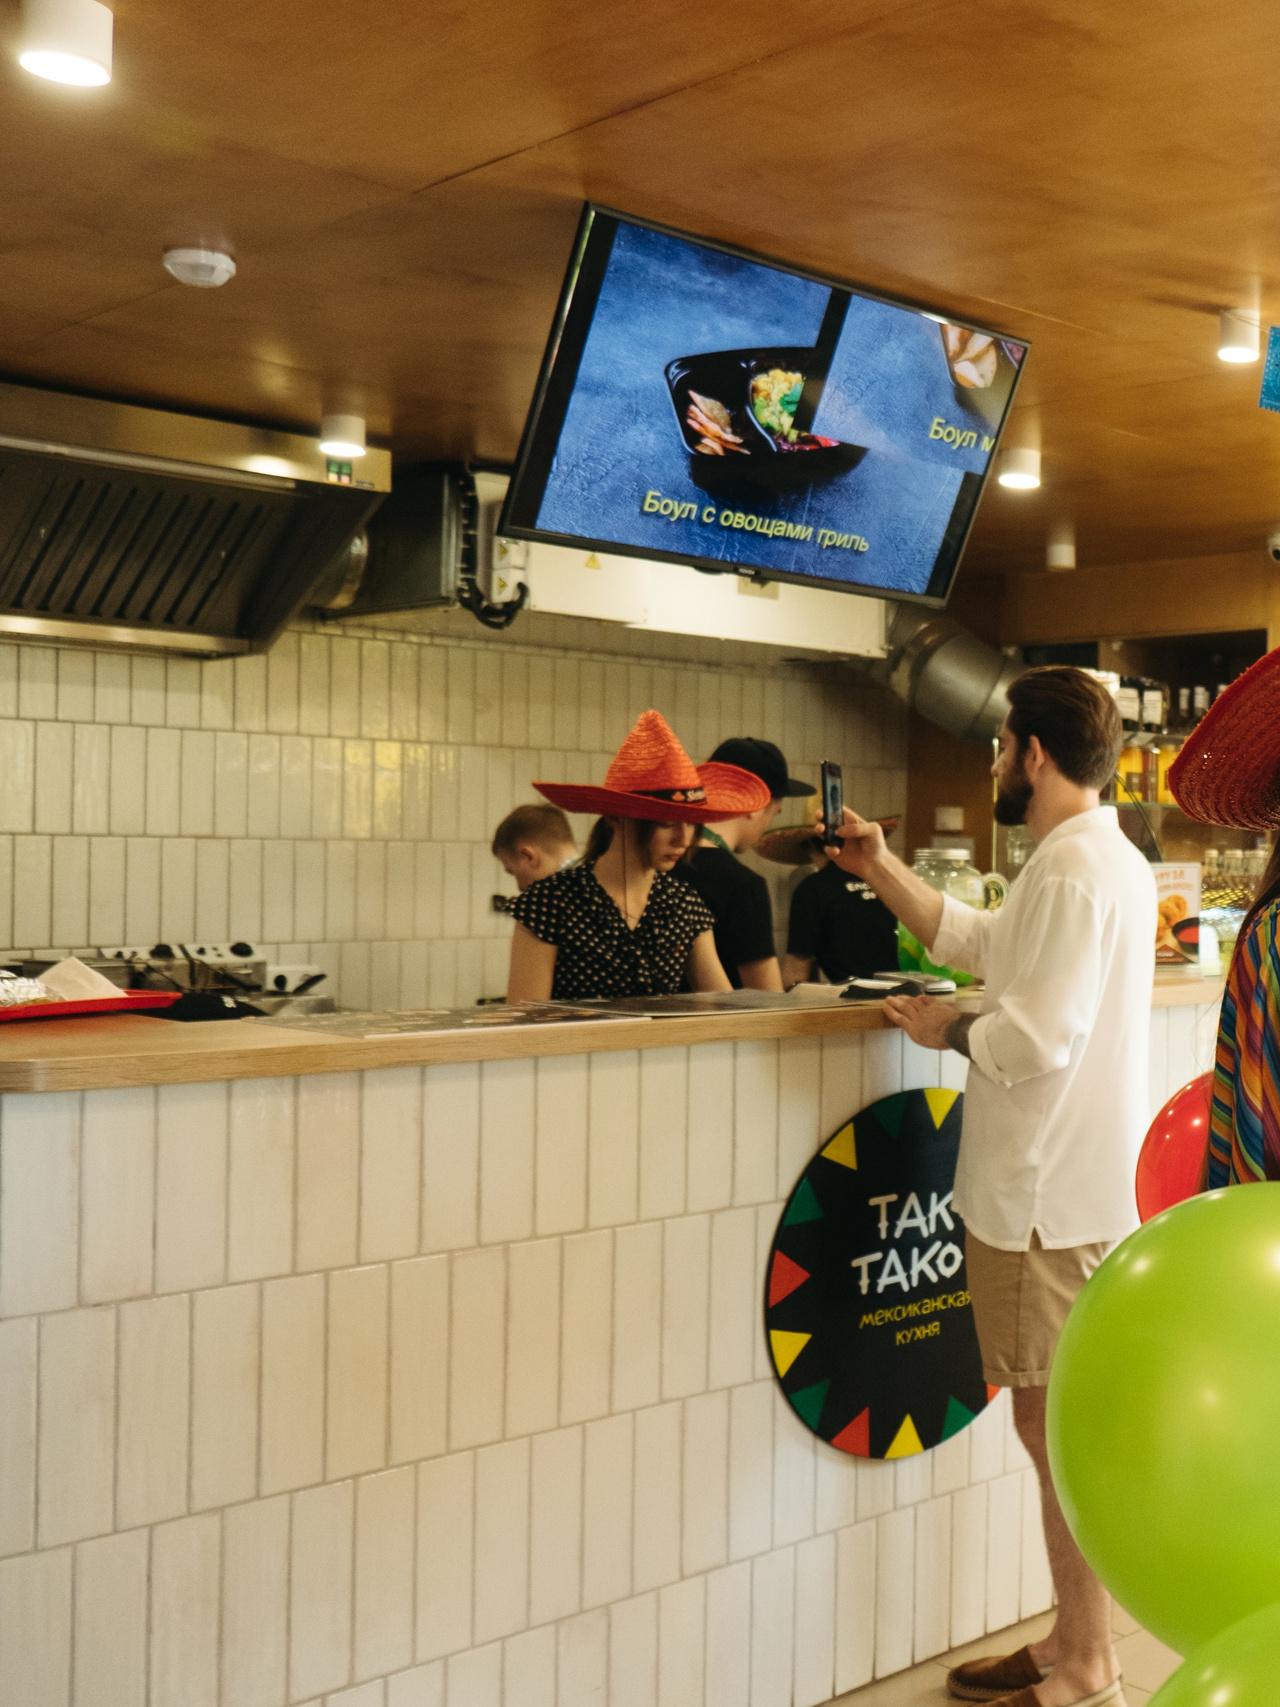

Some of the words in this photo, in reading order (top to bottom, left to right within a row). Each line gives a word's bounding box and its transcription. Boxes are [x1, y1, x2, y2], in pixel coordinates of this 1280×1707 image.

[929, 416, 978, 450] Боул
[643, 490, 698, 521] Боул
[702, 507, 716, 523] с
[720, 510, 813, 540] овощами
[817, 528, 869, 552] гриль
